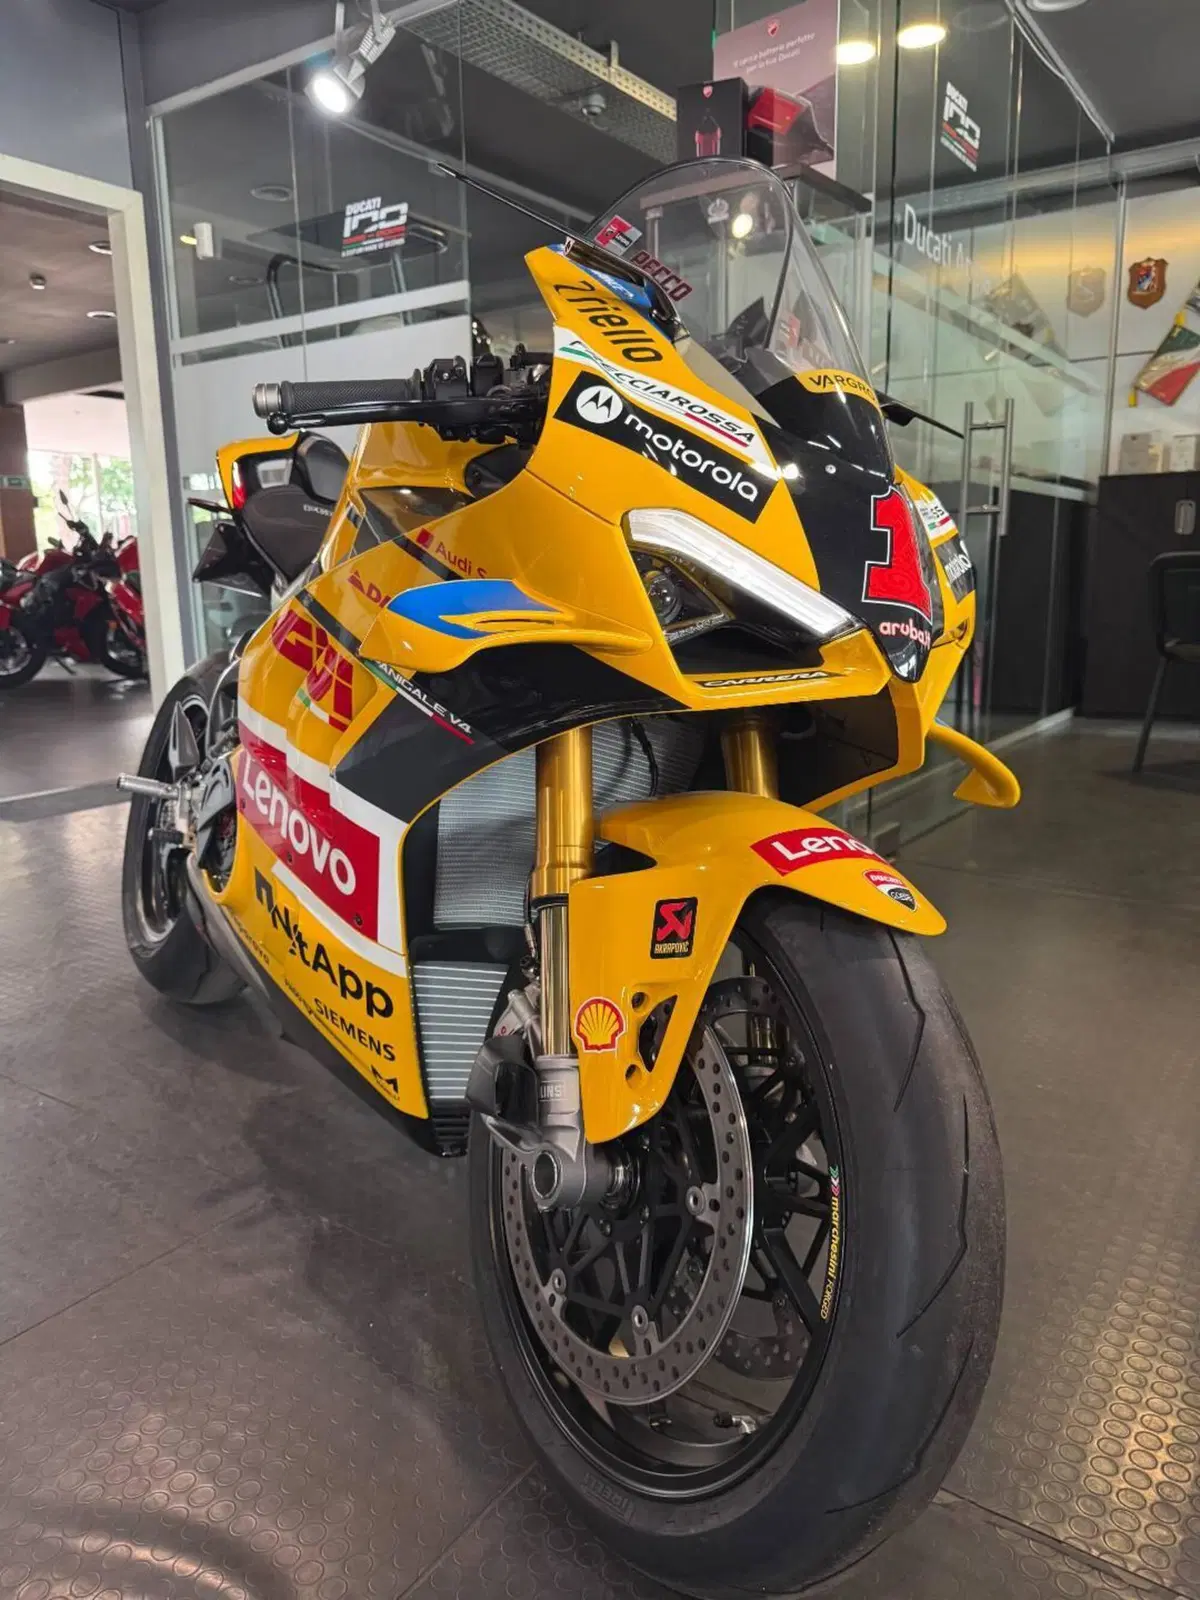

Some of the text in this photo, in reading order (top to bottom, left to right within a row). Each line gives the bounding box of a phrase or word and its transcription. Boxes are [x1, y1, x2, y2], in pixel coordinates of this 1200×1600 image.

[346, 196, 382, 217] DUCATI
[904, 203, 953, 268] Ducati
[624, 414, 759, 502] motorola
[435, 541, 473, 577] Audi
[703, 671, 829, 688] CARRERA
[449, 711, 473, 734] V4
[243, 750, 357, 896] Lenovo
[771, 836, 875, 862] Leno
[313, 997, 397, 1073] SIEMENS
[820, 1196, 840, 1320] marchesini FORGED
